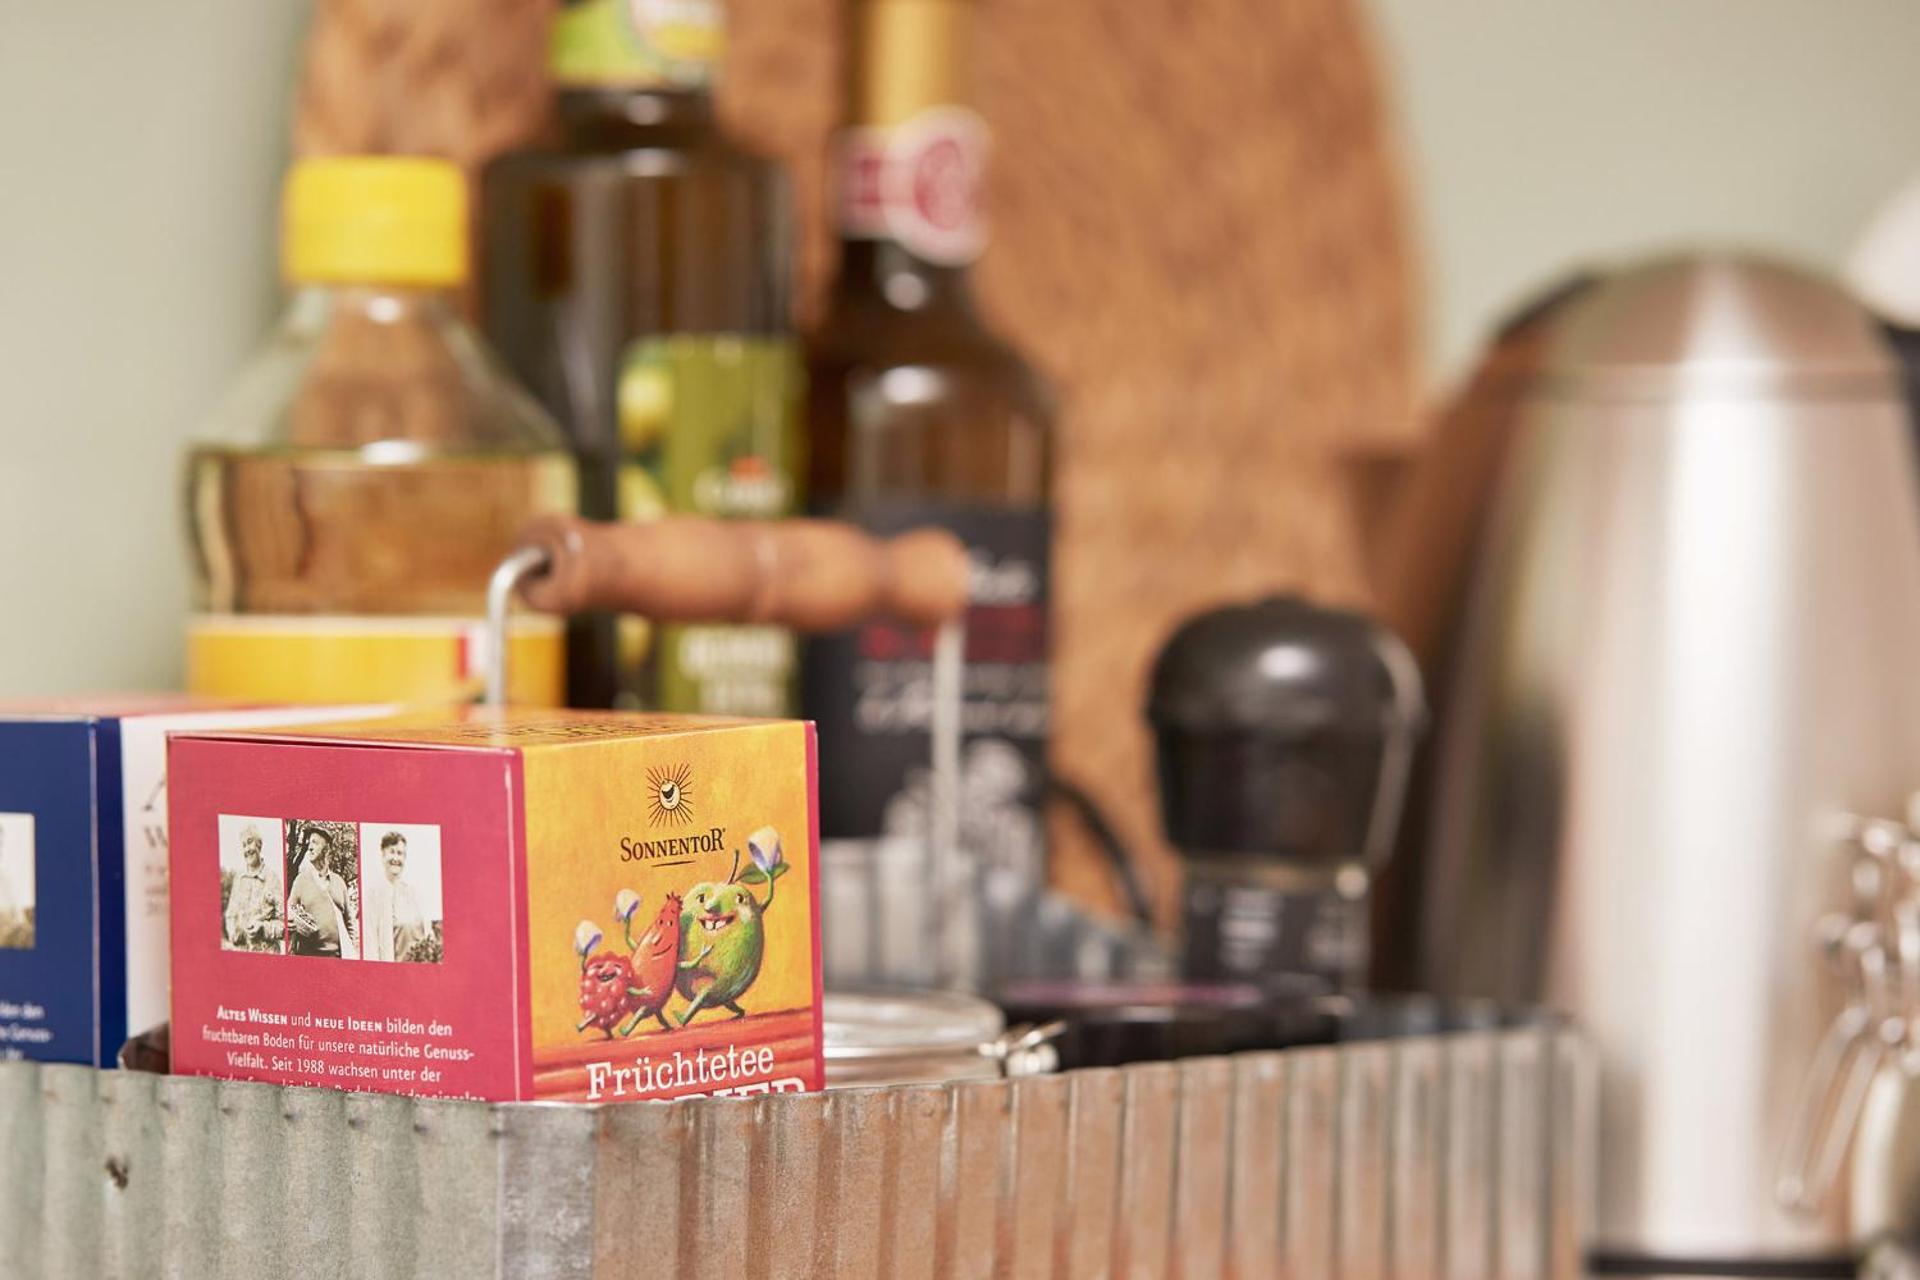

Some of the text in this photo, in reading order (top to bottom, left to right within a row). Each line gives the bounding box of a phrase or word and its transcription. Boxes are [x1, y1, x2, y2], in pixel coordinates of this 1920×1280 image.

[291, 1012, 311, 1028] und
[386, 1017, 425, 1034] bilden
[428, 1020, 453, 1036] den
[202, 1024, 475, 1061] fruchtbaren Boden für unsere natürliche Genuss-
[226, 1051, 441, 1082] Vielfalt. Seit 1988 wachsen unter der
[585, 1044, 774, 1099] Früchtetee
